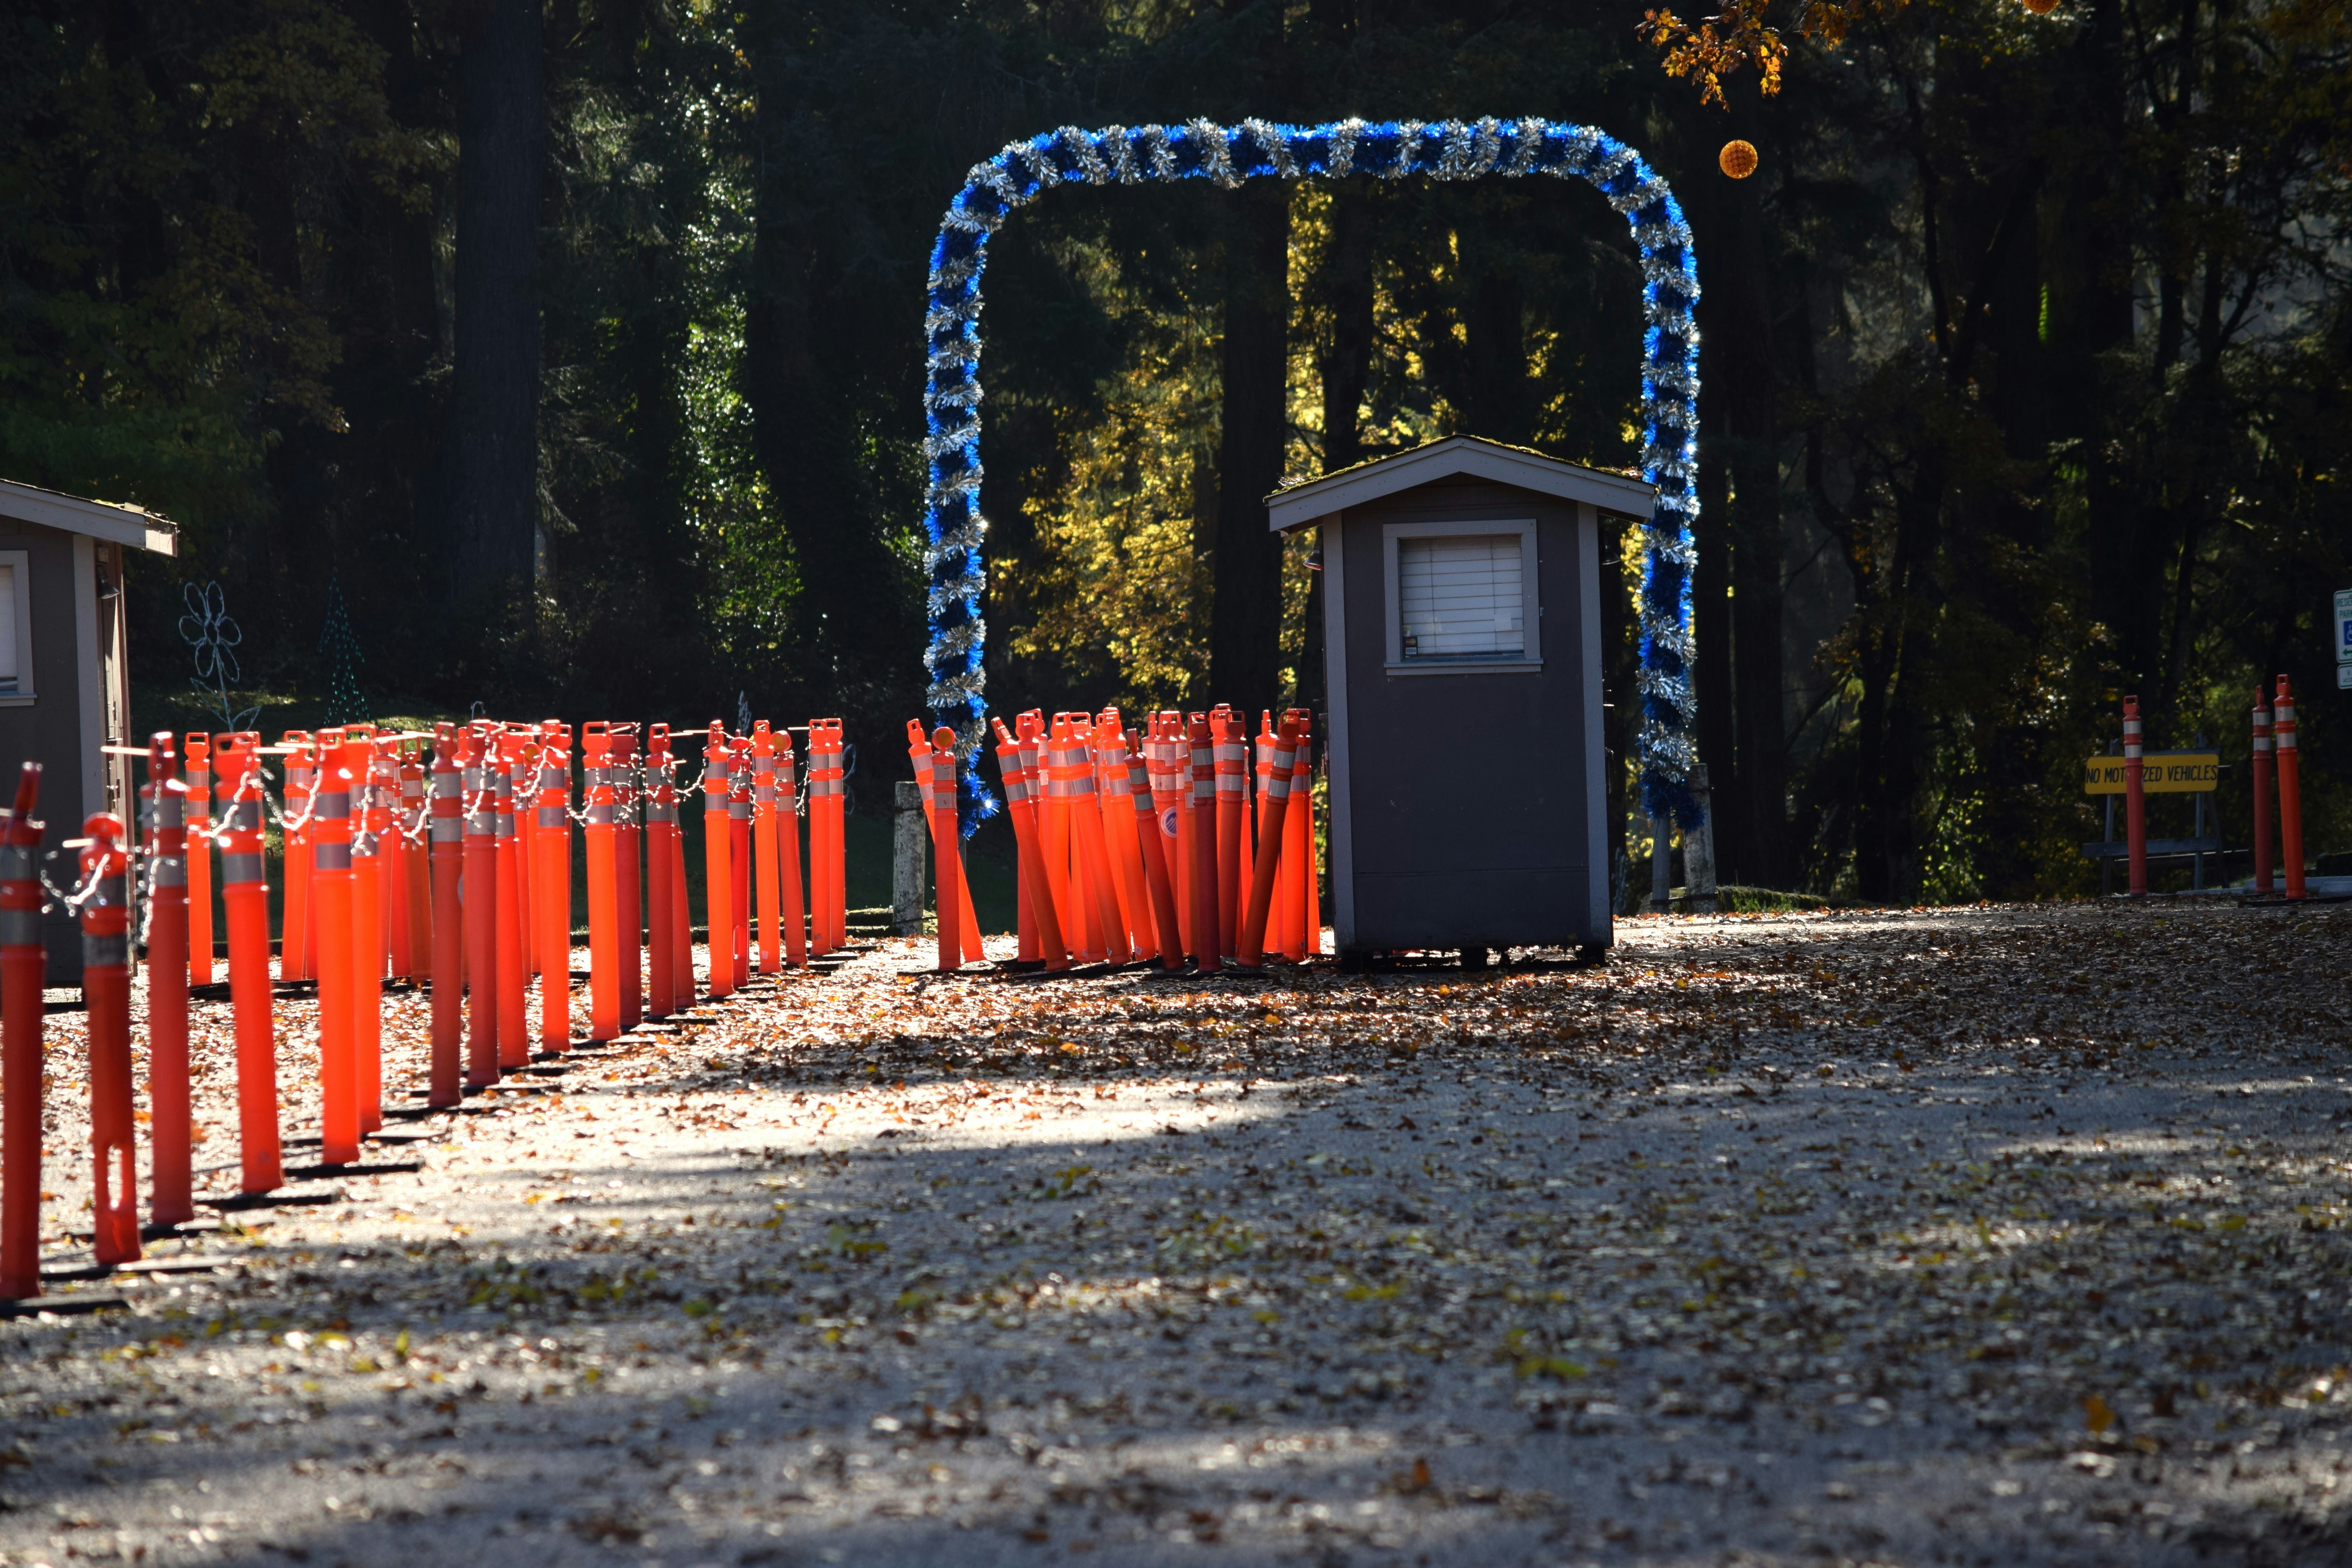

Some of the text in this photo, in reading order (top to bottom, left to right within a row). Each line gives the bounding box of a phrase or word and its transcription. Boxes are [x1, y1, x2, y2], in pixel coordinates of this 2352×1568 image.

[2337, 598, 2352, 607] RESE
[2086, 765, 2217, 783] NO MOTZED VEHICLES
